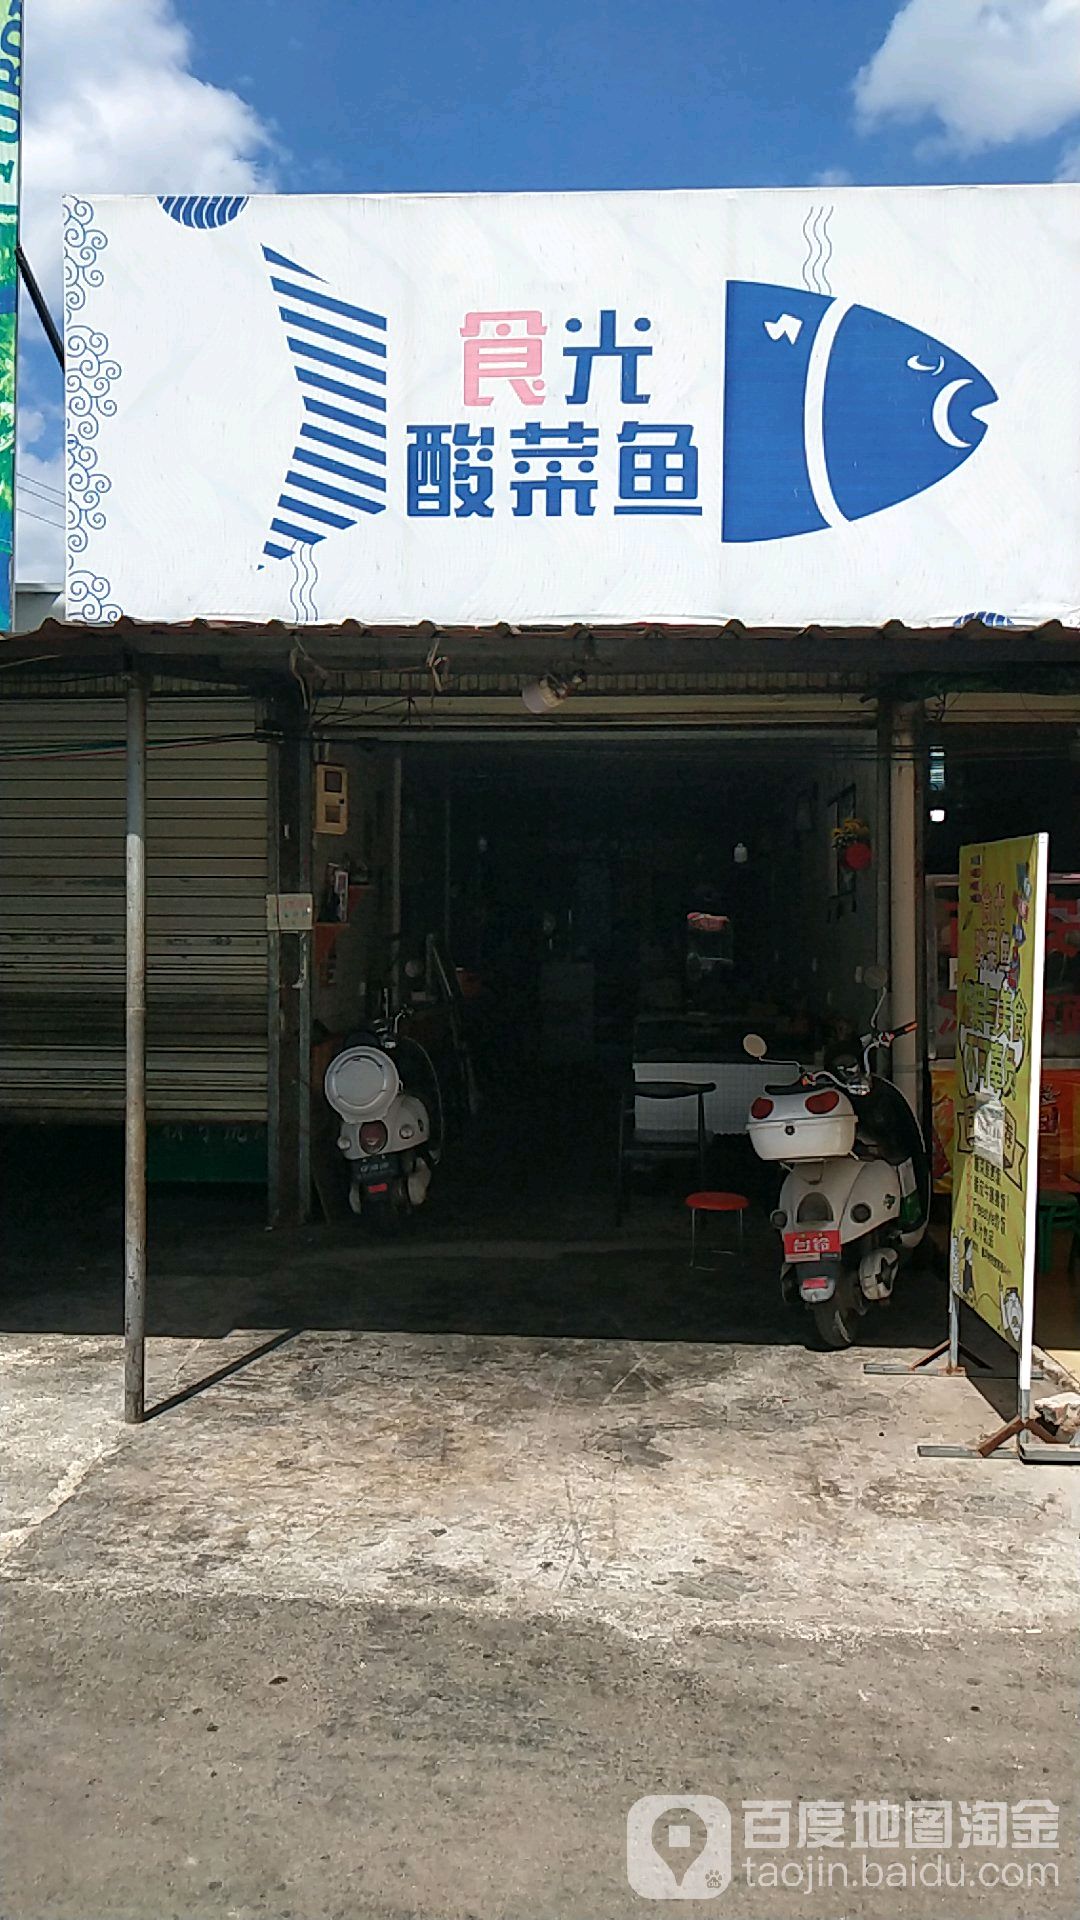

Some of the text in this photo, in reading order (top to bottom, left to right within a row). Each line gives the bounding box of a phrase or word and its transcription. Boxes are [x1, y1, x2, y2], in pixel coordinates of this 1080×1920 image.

[459, 310, 653, 407] 食光
[406, 421, 703, 518] 酸菜鱼
